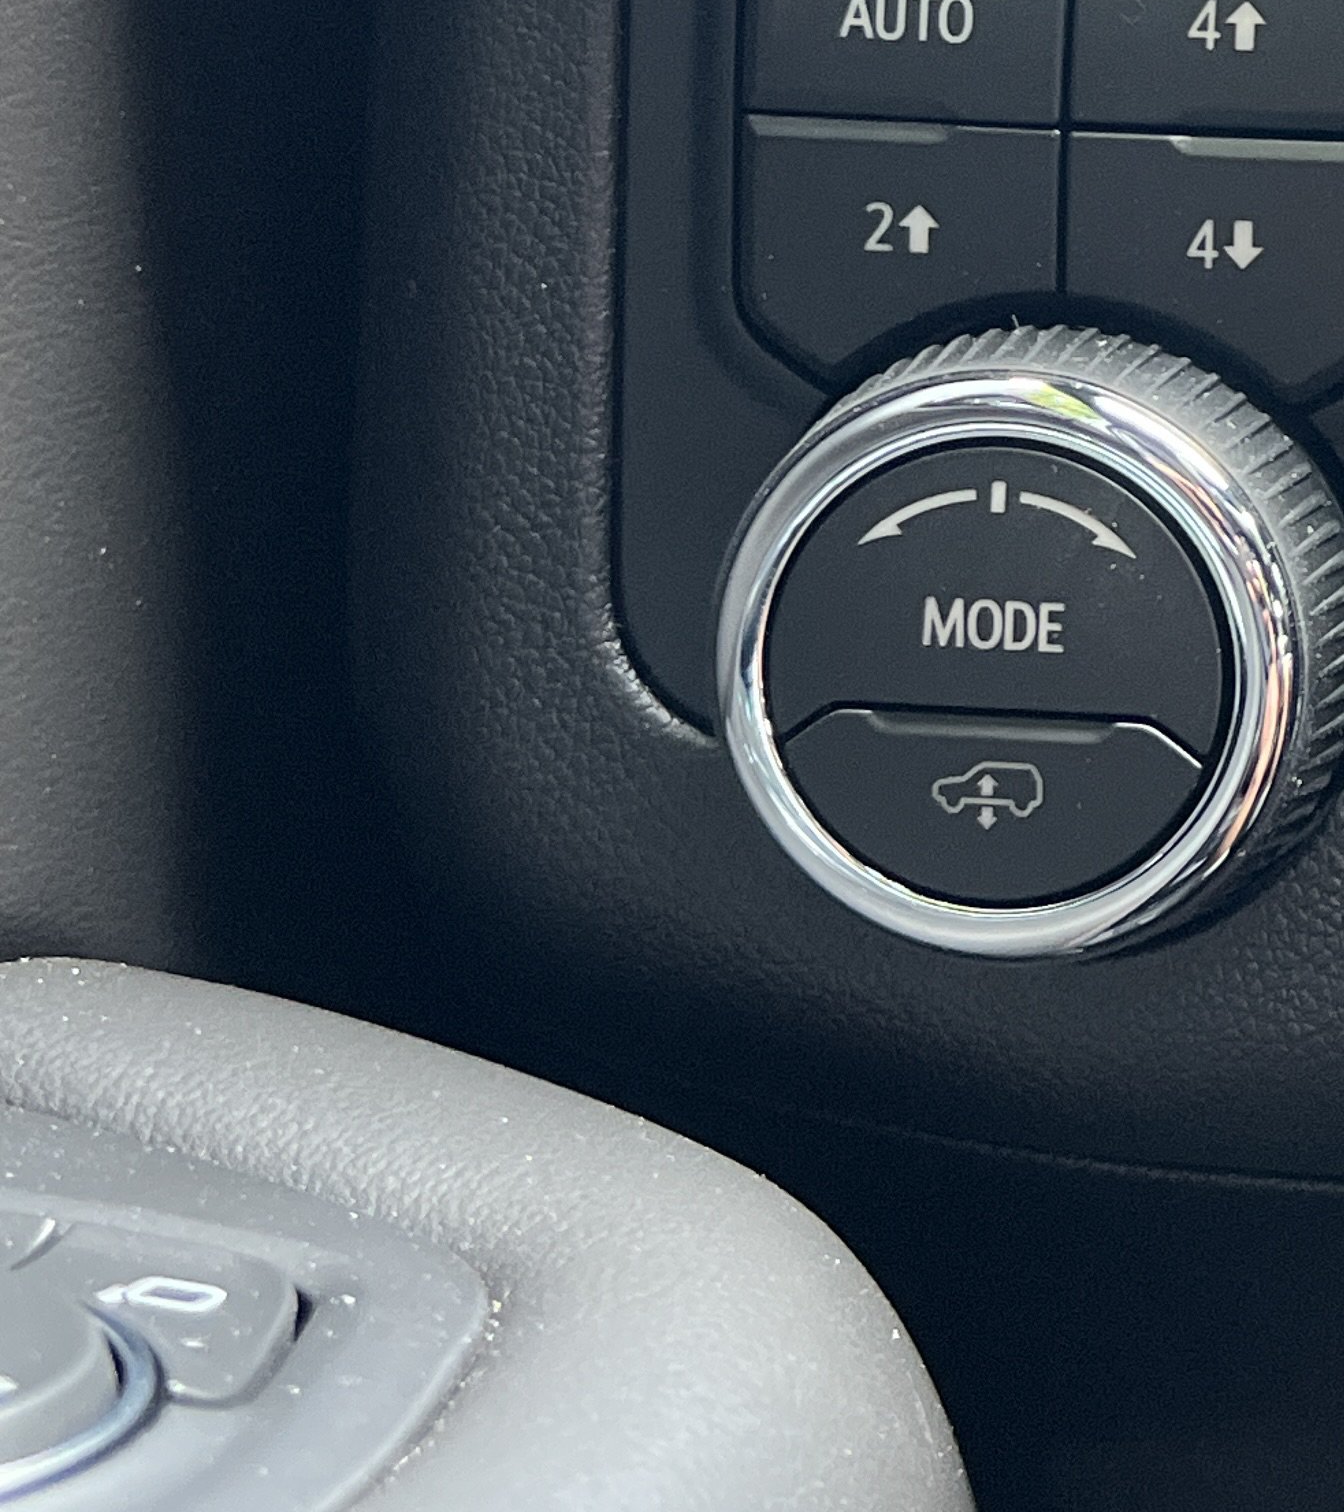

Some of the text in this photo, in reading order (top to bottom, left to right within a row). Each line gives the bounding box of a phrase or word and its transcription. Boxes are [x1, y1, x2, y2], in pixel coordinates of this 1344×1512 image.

[864, 201, 894, 252] 2
[1186, 219, 1219, 269] 4
[922, 596, 1065, 653] MODE
